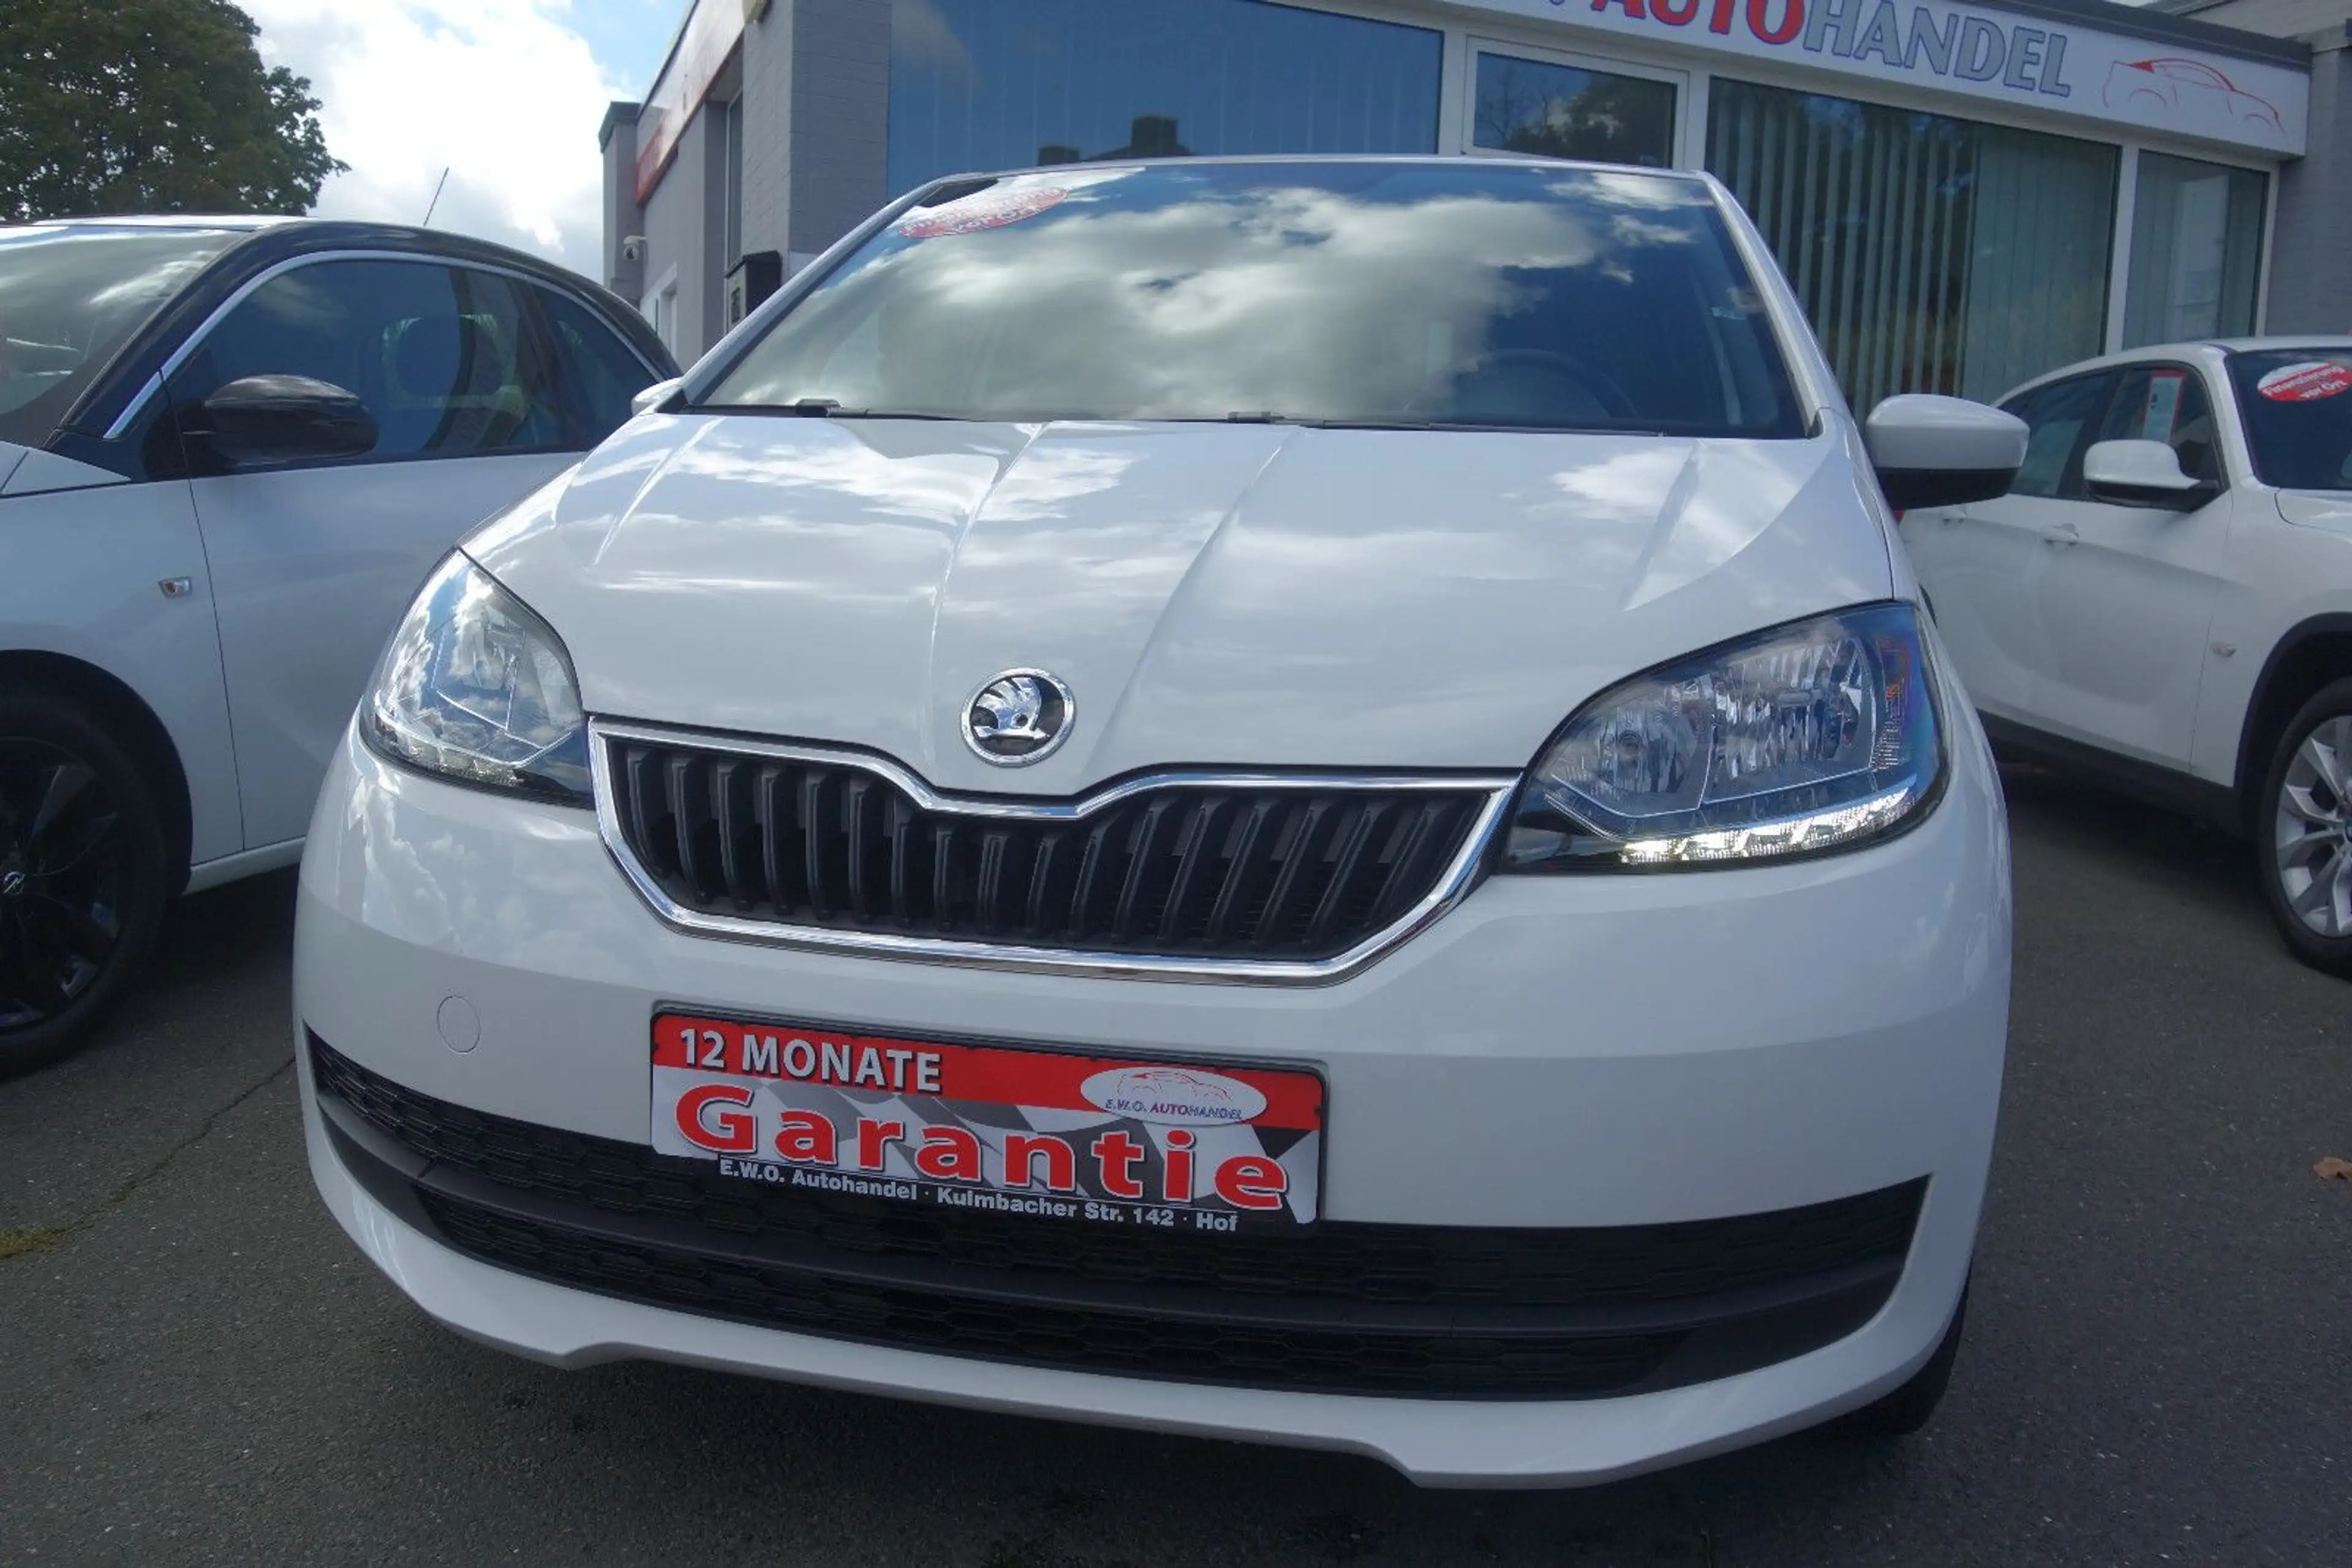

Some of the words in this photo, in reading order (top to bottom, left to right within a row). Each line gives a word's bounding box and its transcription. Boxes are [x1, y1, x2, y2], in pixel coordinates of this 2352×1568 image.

[1591, 0, 2070, 97] OHANDEL
[680, 1028, 726, 1069] 12
[742, 1034, 941, 1091] MONATE
[1105, 1098, 1146, 1112] E.W.O.
[1150, 1103, 1242, 1120] AUTOHANDEL
[675, 1084, 1288, 1210] Garantie
[720, 1158, 785, 1183] E.W.O.
[791, 1168, 918, 1200] Autohandel
[937, 1186, 1078, 1218] Kulmbacher
[1084, 1203, 1125, 1223] Str.
[1133, 1207, 1175, 1227] 142
[1196, 1212, 1239, 1232] Hof
